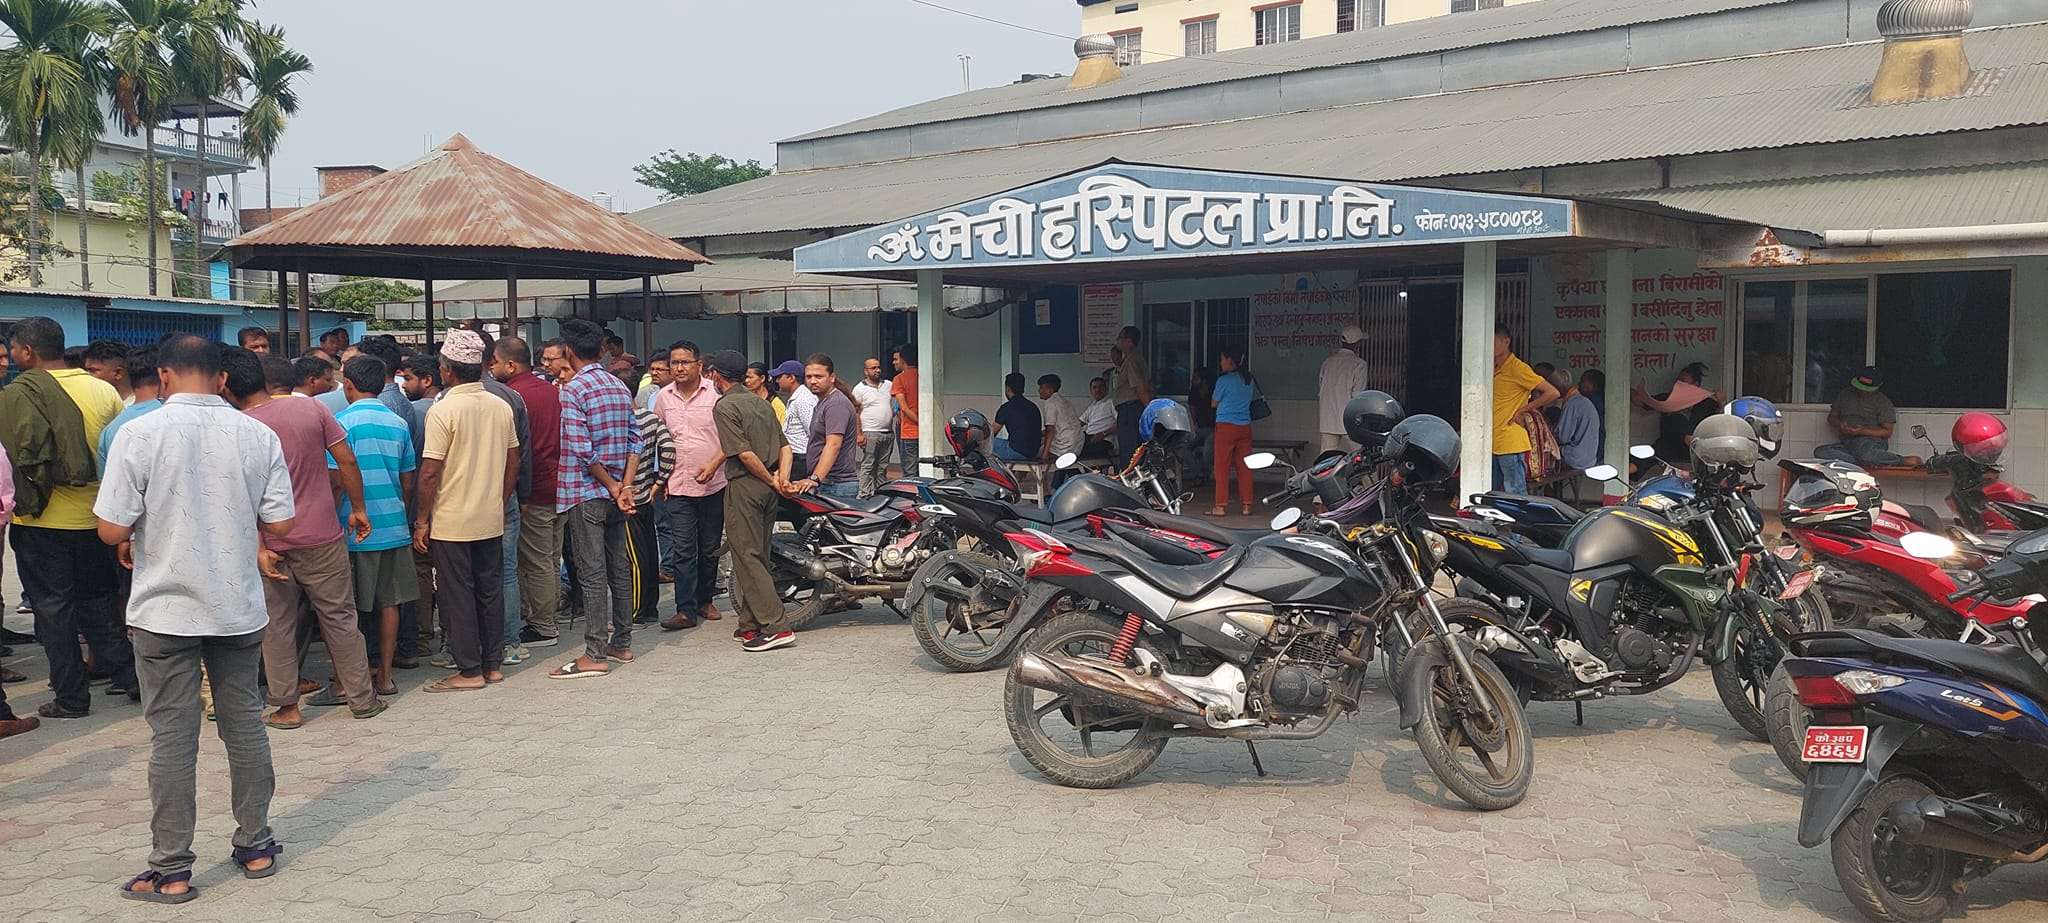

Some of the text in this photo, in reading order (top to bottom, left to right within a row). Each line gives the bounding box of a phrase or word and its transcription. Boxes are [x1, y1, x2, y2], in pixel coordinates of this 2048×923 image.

[925, 198, 1037, 261] मेची
[1040, 174, 1260, 262] हस्पिटल
[1807, 745, 1858, 758] ६४६५
